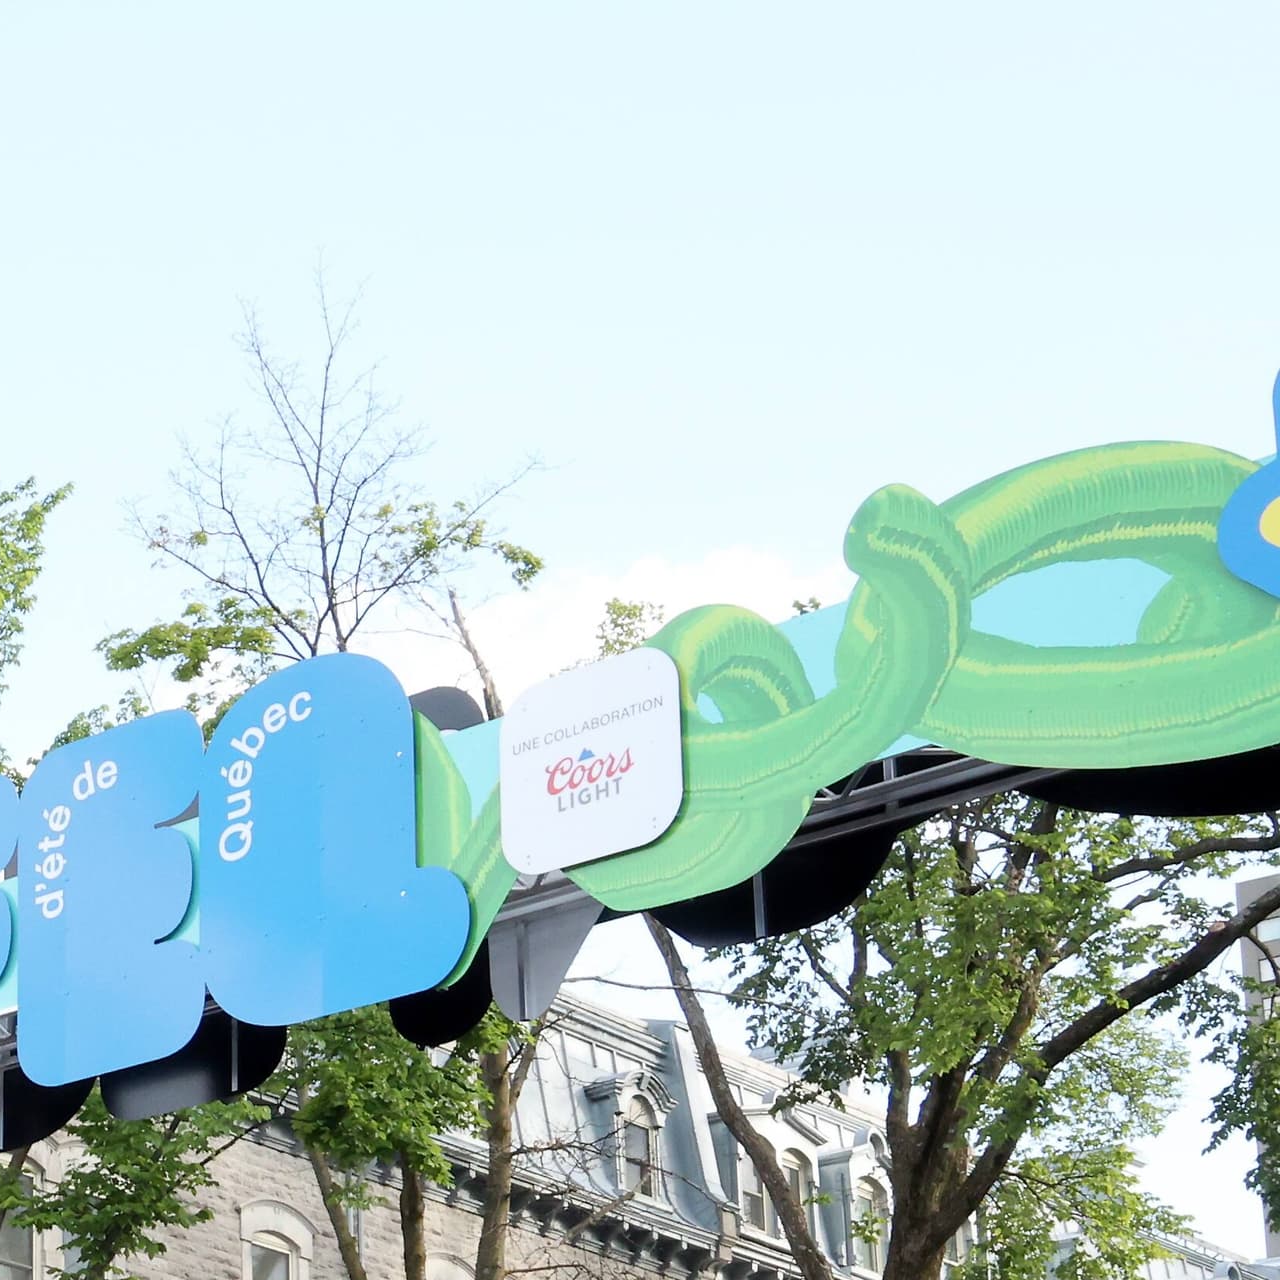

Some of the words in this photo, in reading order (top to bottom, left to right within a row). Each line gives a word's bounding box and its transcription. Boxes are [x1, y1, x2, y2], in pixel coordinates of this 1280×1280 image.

[512, 737, 540, 756] UNE
[544, 695, 663, 745] COLLABORATION
[218, 691, 313, 862] Québec
[545, 747, 634, 796] Coors
[558, 777, 622, 813] LIGHT
[35, 805, 71, 919] d'été
[72, 760, 118, 801] de
